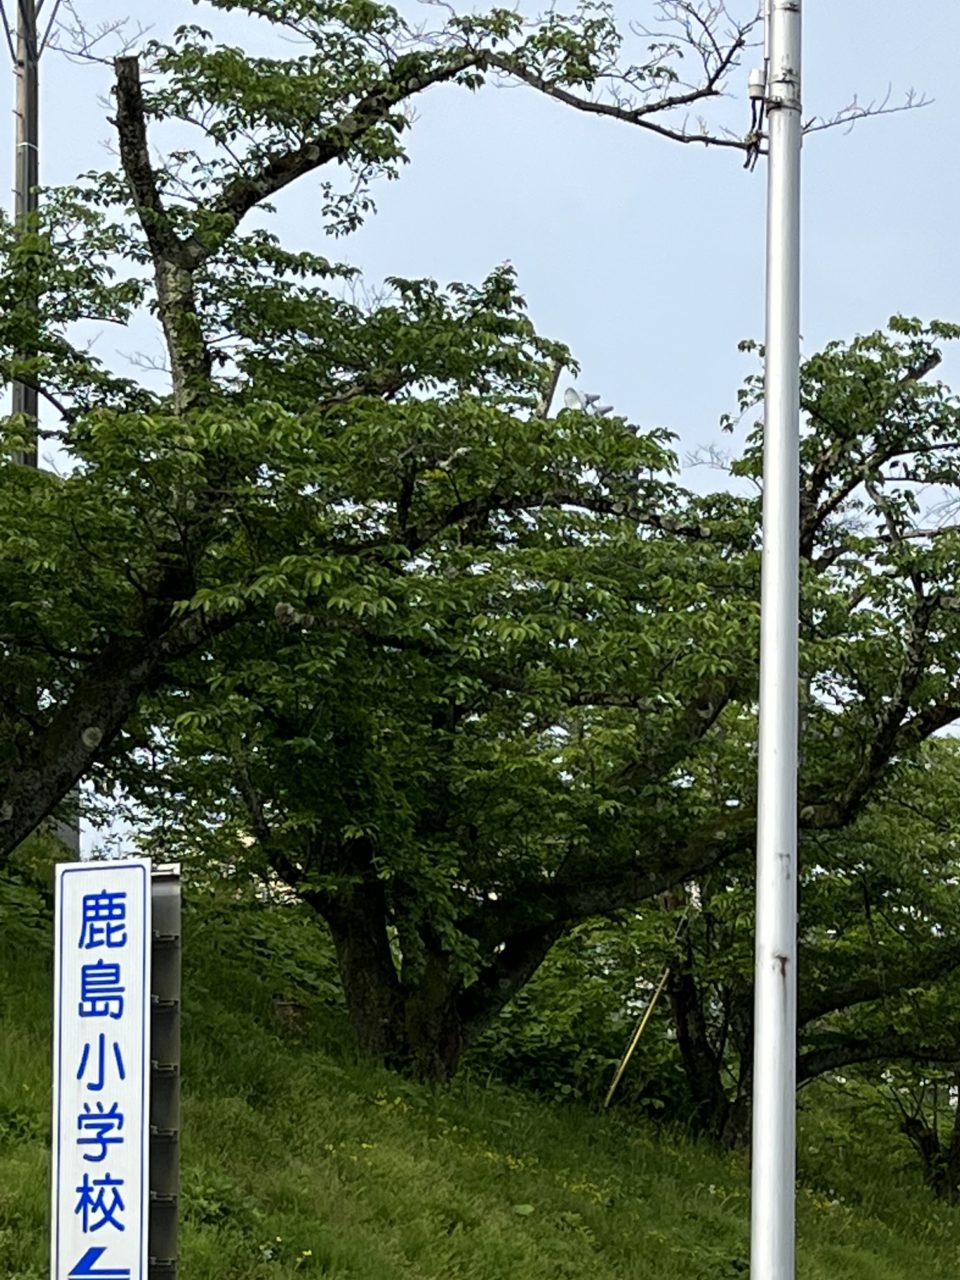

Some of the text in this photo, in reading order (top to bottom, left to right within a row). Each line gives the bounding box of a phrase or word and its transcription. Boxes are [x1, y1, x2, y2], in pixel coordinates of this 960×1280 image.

[75, 889, 128, 1233] 鹿島小学校
